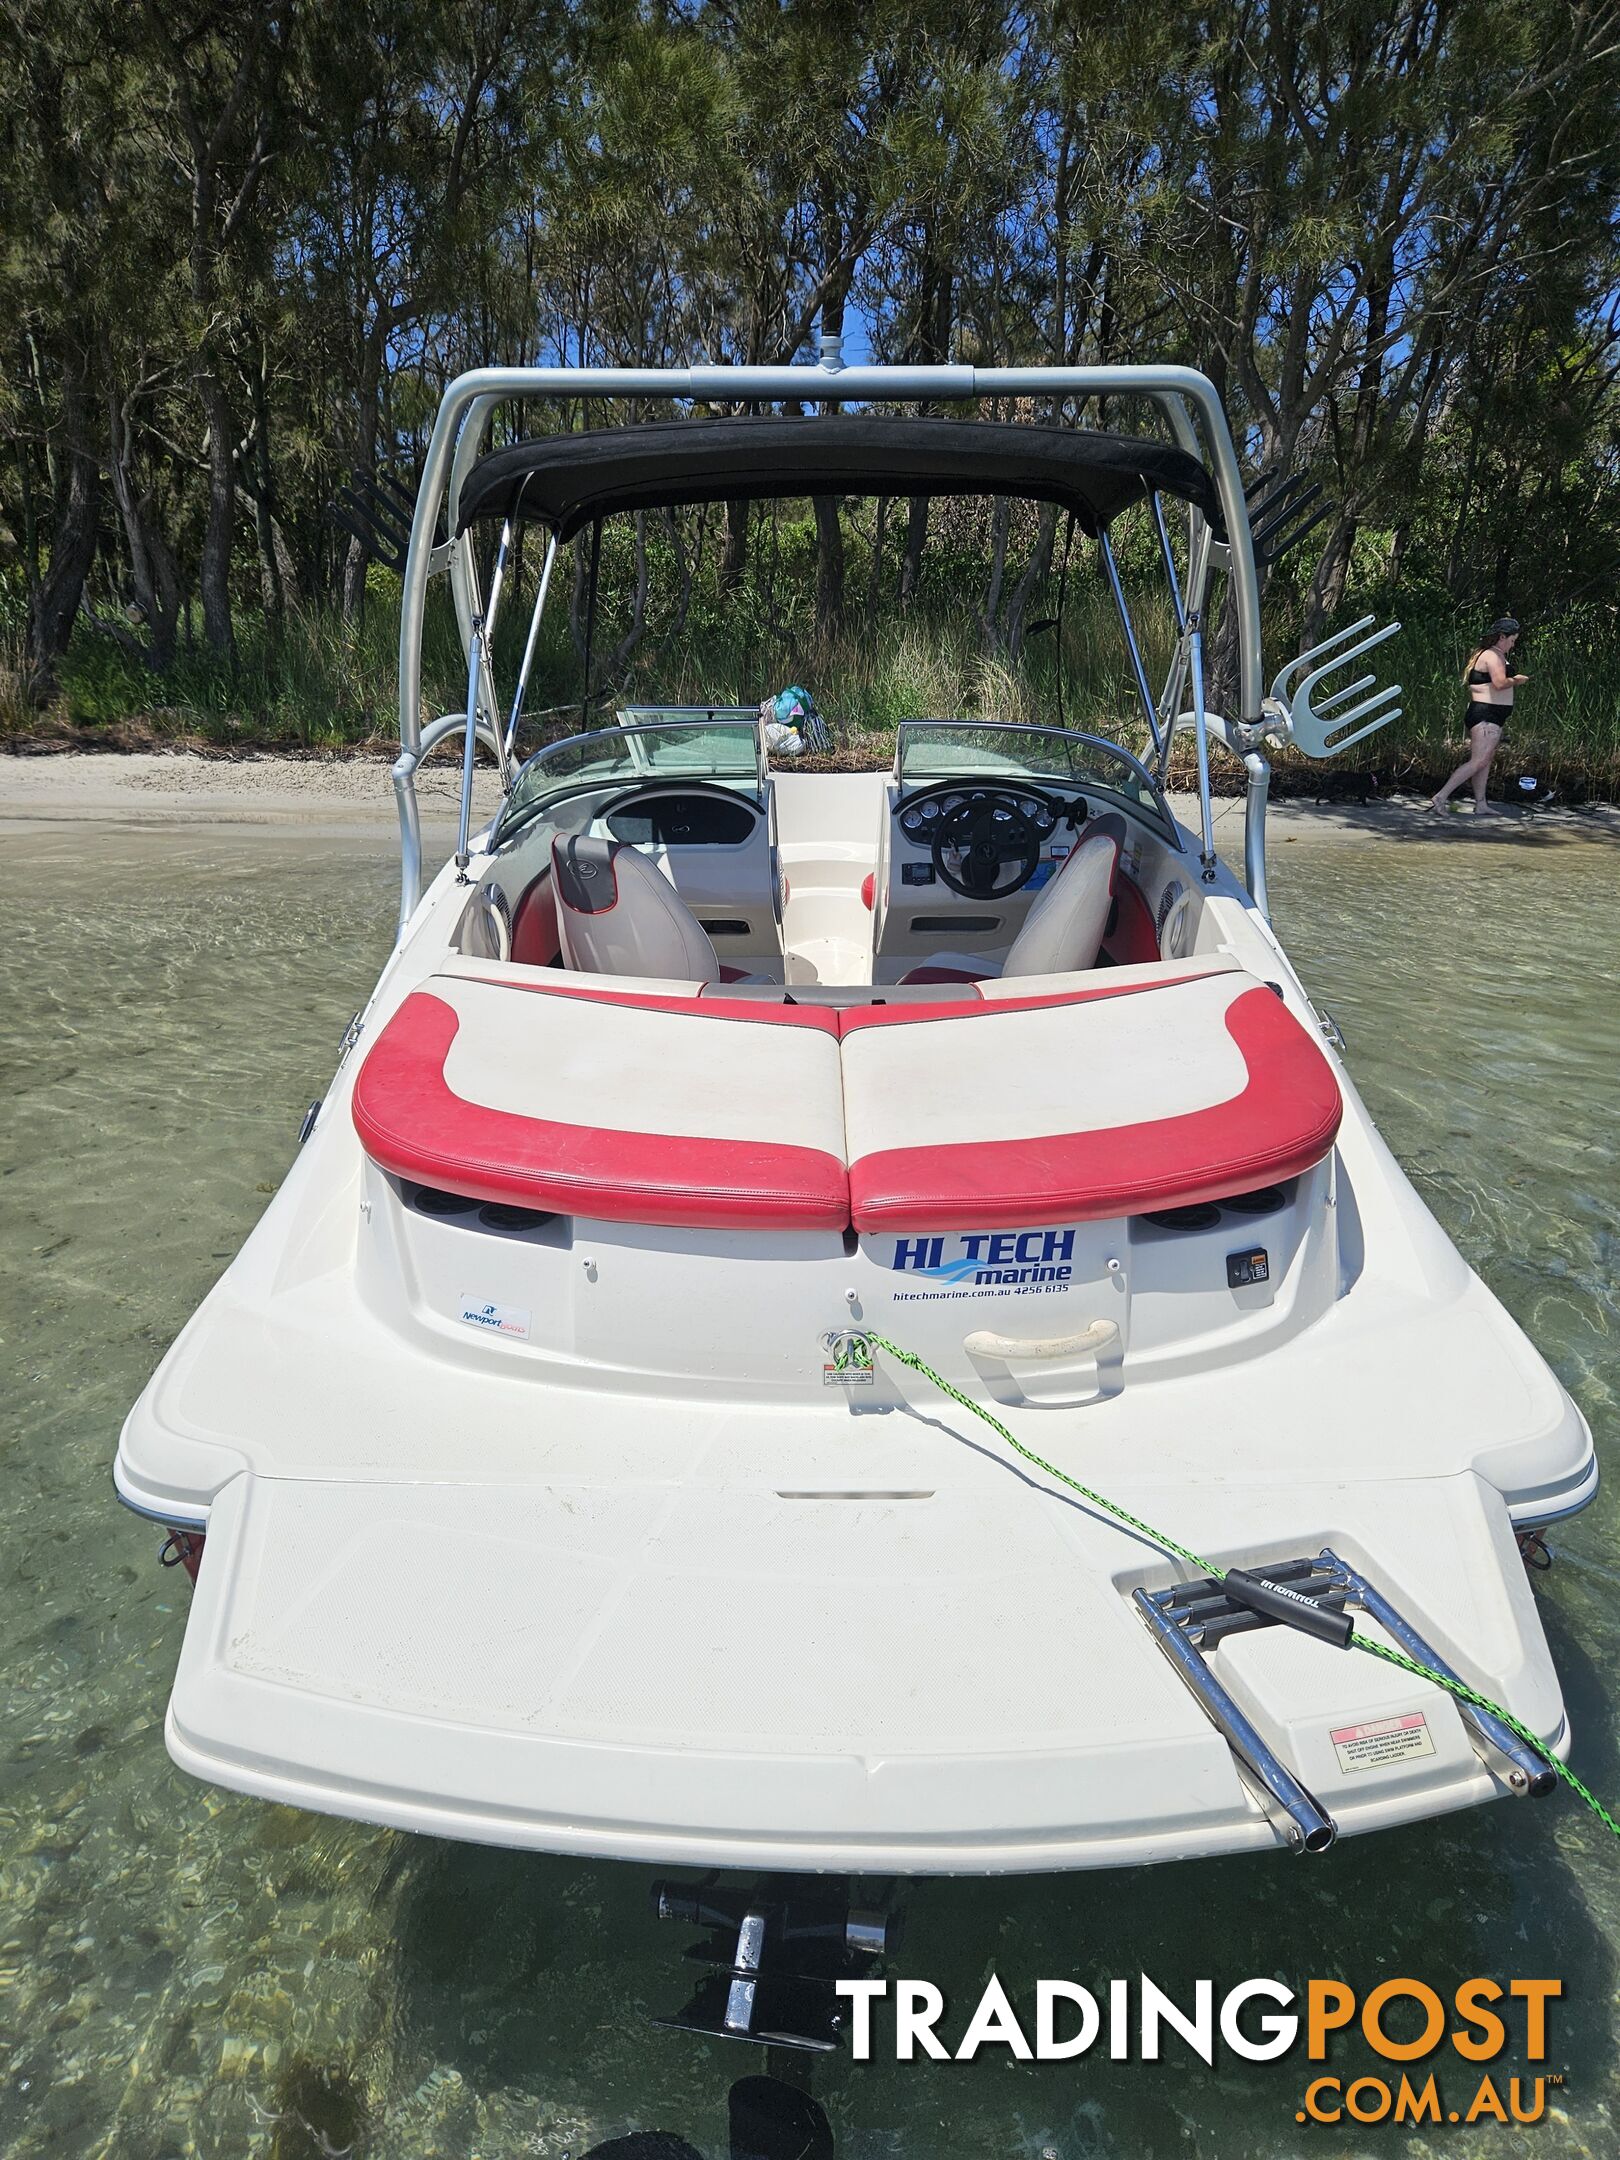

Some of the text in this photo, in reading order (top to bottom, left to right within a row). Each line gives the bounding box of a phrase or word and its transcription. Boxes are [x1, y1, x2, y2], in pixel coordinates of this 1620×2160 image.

[892, 1229, 1076, 1270] HI TECH
[975, 1263, 1072, 1285] marine
[893, 1284, 1069, 1301] hitechmarine.com.au 4256 6135
